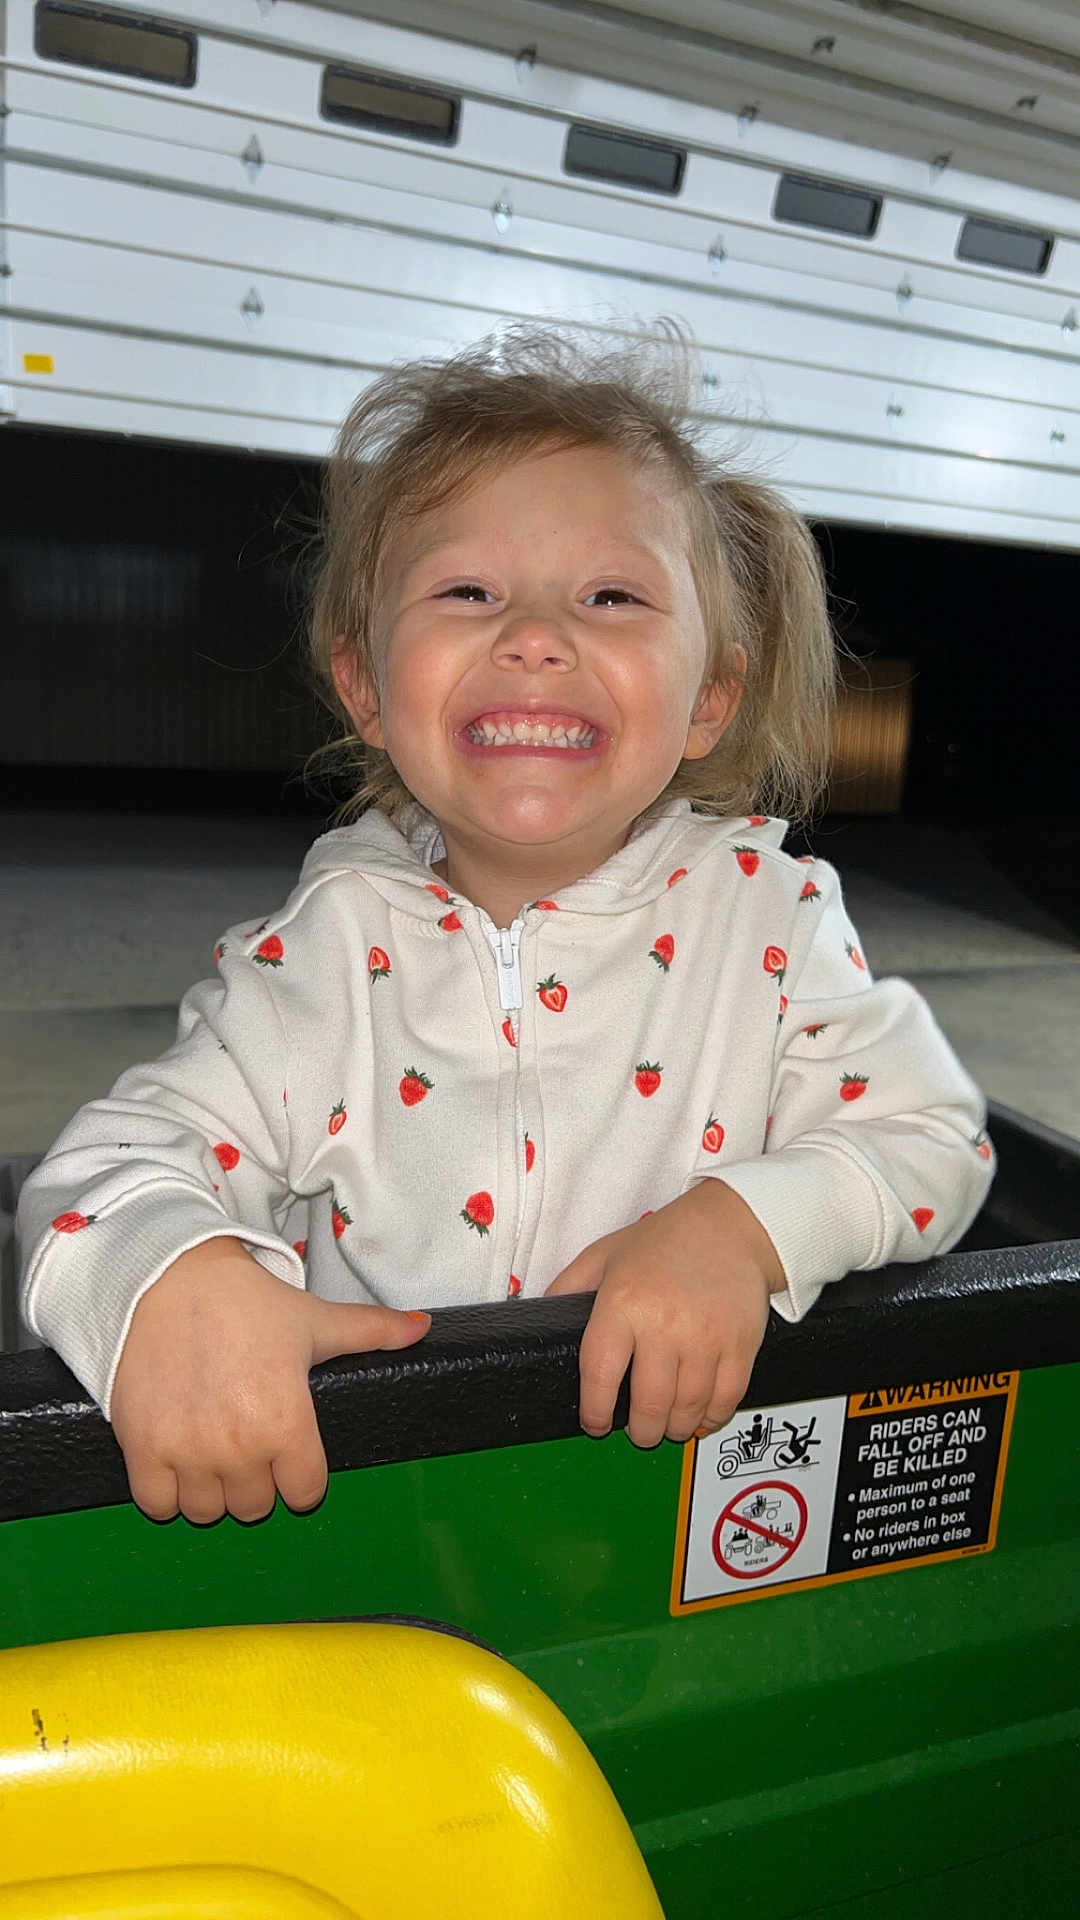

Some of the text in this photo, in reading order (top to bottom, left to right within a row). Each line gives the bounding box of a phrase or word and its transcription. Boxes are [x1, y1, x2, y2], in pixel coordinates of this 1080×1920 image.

[884, 1372, 1011, 1406] WARNING
[870, 1407, 981, 1441] RIDERS CAN
[857, 1426, 987, 1462] FALL OFF AND
[873, 1448, 967, 1479] BE KILLED
[859, 1472, 976, 1503] Maximum of one
[856, 1489, 970, 1523] person to a seat
[852, 1527, 972, 1560] or anywhere else
[854, 1511, 966, 1543] No riders in box
